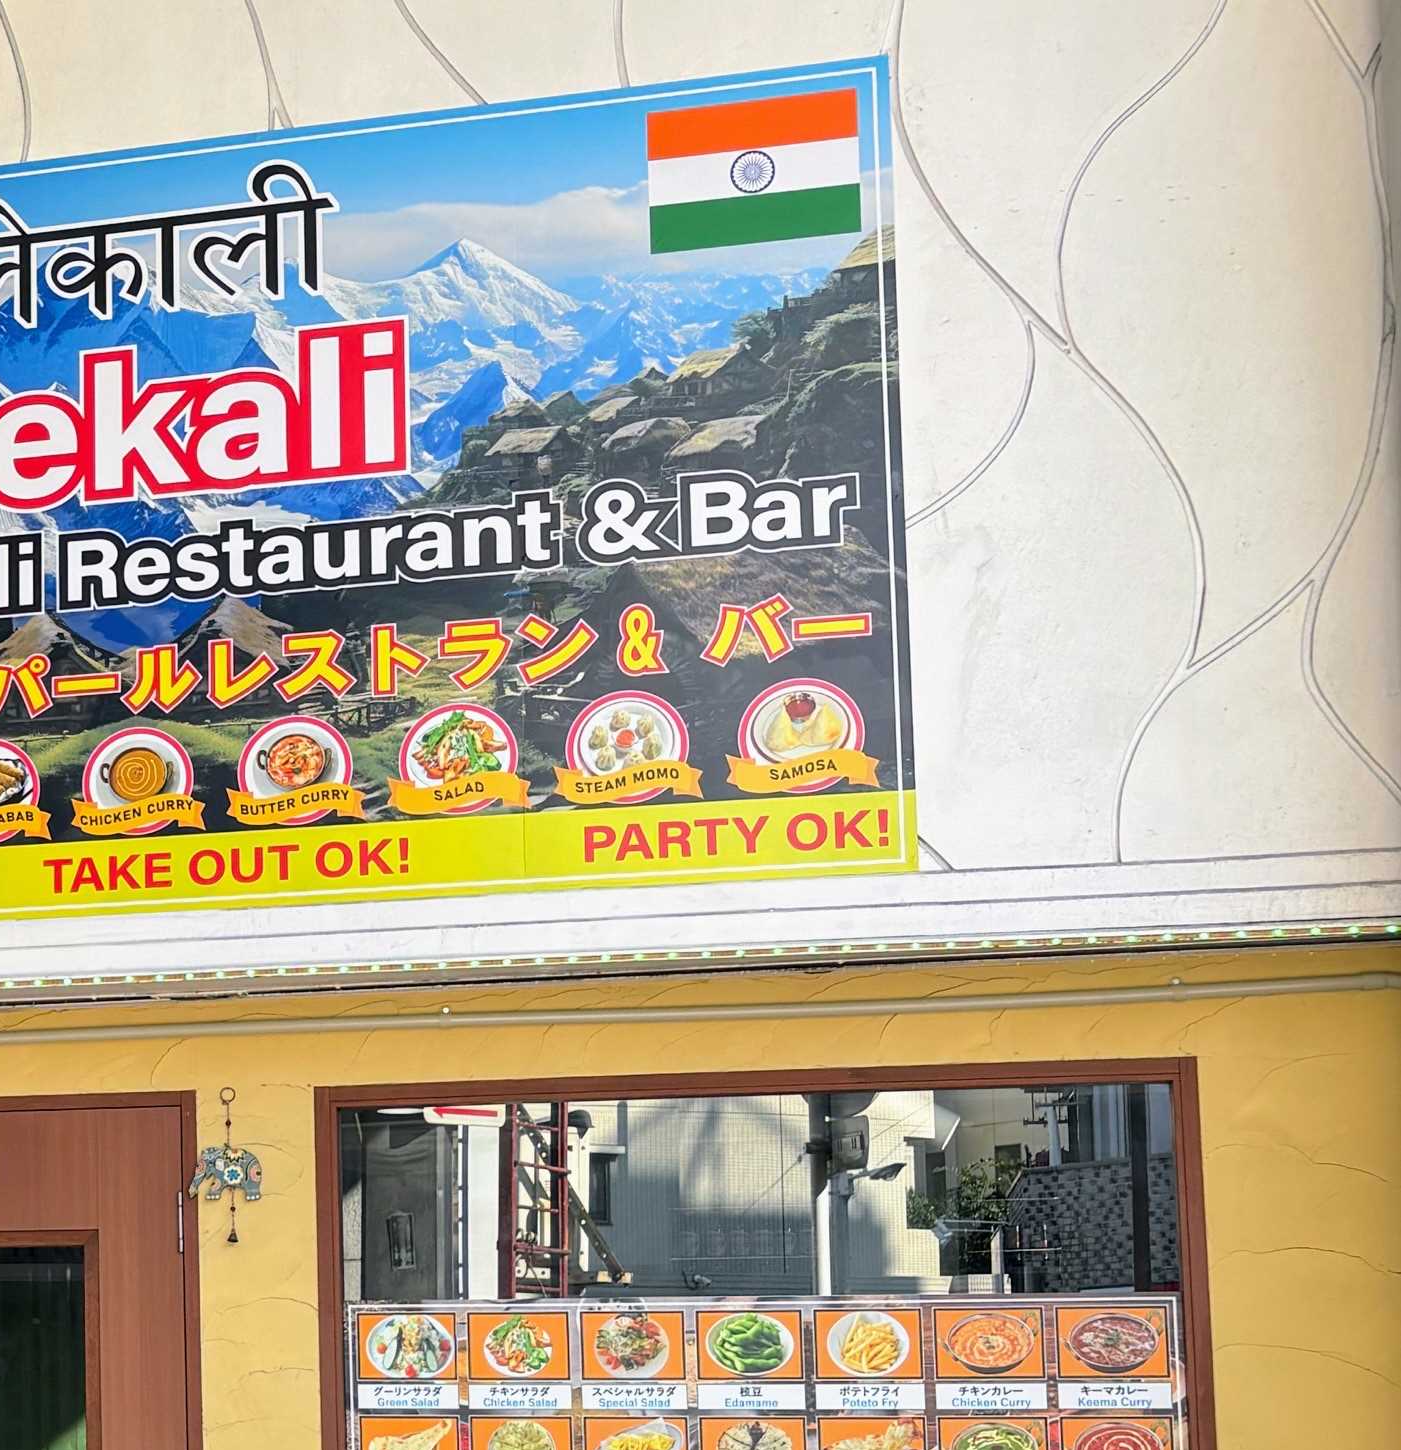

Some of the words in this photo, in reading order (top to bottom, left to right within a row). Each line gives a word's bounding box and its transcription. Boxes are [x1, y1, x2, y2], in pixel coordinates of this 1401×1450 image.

[66, 497, 556, 604] Restaurant
[588, 484, 662, 560] &
[687, 474, 856, 550] Bar
[617, 602, 665, 677] &
[703, 594, 872, 666] バー
[575, 773, 627, 796] STEAM
[631, 766, 681, 787] MOMO
[768, 758, 840, 782] SAMOSA
[239, 795, 295, 817] BUTTER
[299, 788, 351, 808] CURRY
[433, 782, 486, 804] SALAD
[79, 806, 143, 828] CHICKEN
[146, 798, 196, 817] CURRY
[583, 816, 763, 863] PARTY
[787, 808, 891, 852] OK!
[43, 850, 173, 896] TAKE
[198, 842, 300, 887] OUT
[315, 837, 411, 878] OK!
[958, 1386, 1023, 1396] チキンカレー
[377, 1397, 408, 1408] Green
[410, 1397, 440, 1407] Salad
[483, 1398, 525, 1408] Chicken
[528, 1398, 558, 1408] Salad
[598, 1398, 639, 1410] Special
[640, 1398, 671, 1408] Salad
[724, 1398, 778, 1408] Edamame
[881, 1398, 899, 1409] Fry
[951, 1397, 998, 1408] Chicken
[1000, 1397, 1031, 1409] Curry
[1077, 1397, 1119, 1408] Keema
[1121, 1397, 1153, 1409] Curry
